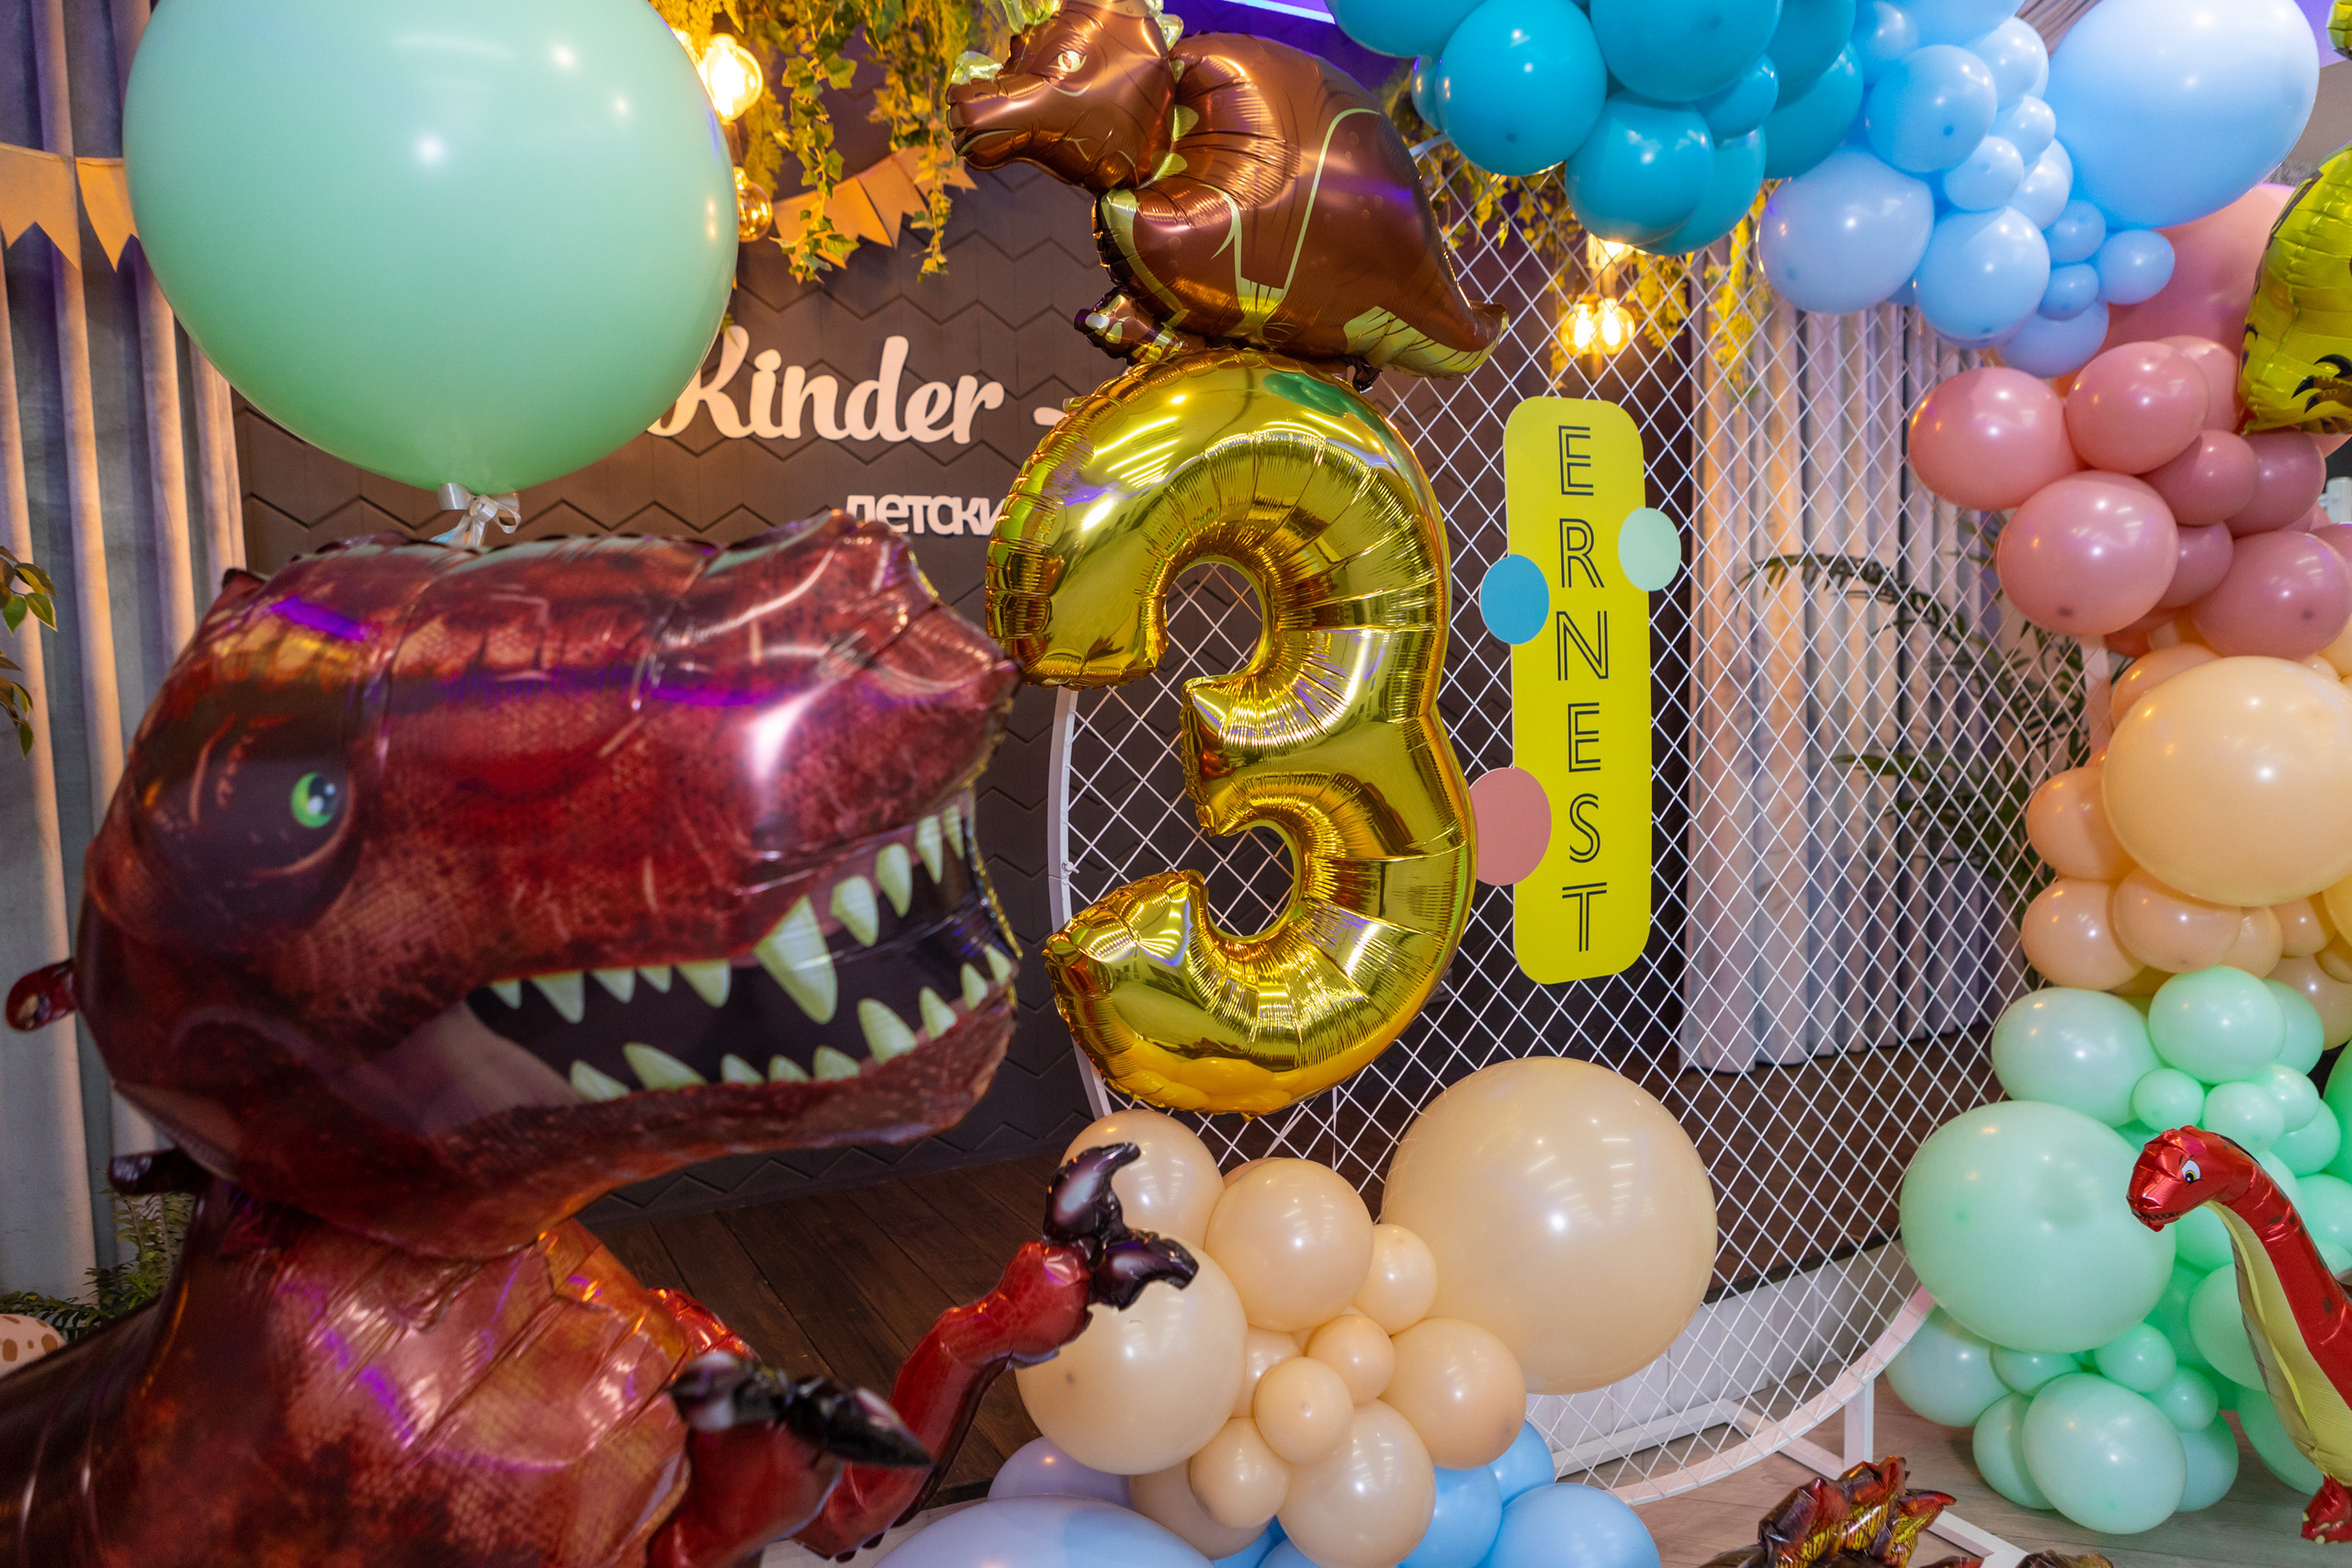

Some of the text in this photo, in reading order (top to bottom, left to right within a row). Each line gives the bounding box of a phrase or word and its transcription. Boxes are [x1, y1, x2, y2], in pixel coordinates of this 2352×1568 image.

[646, 324, 1005, 445] Kinder
[986, 348, 1476, 1118] 3
[1555, 423, 1610, 953] ERNEST
